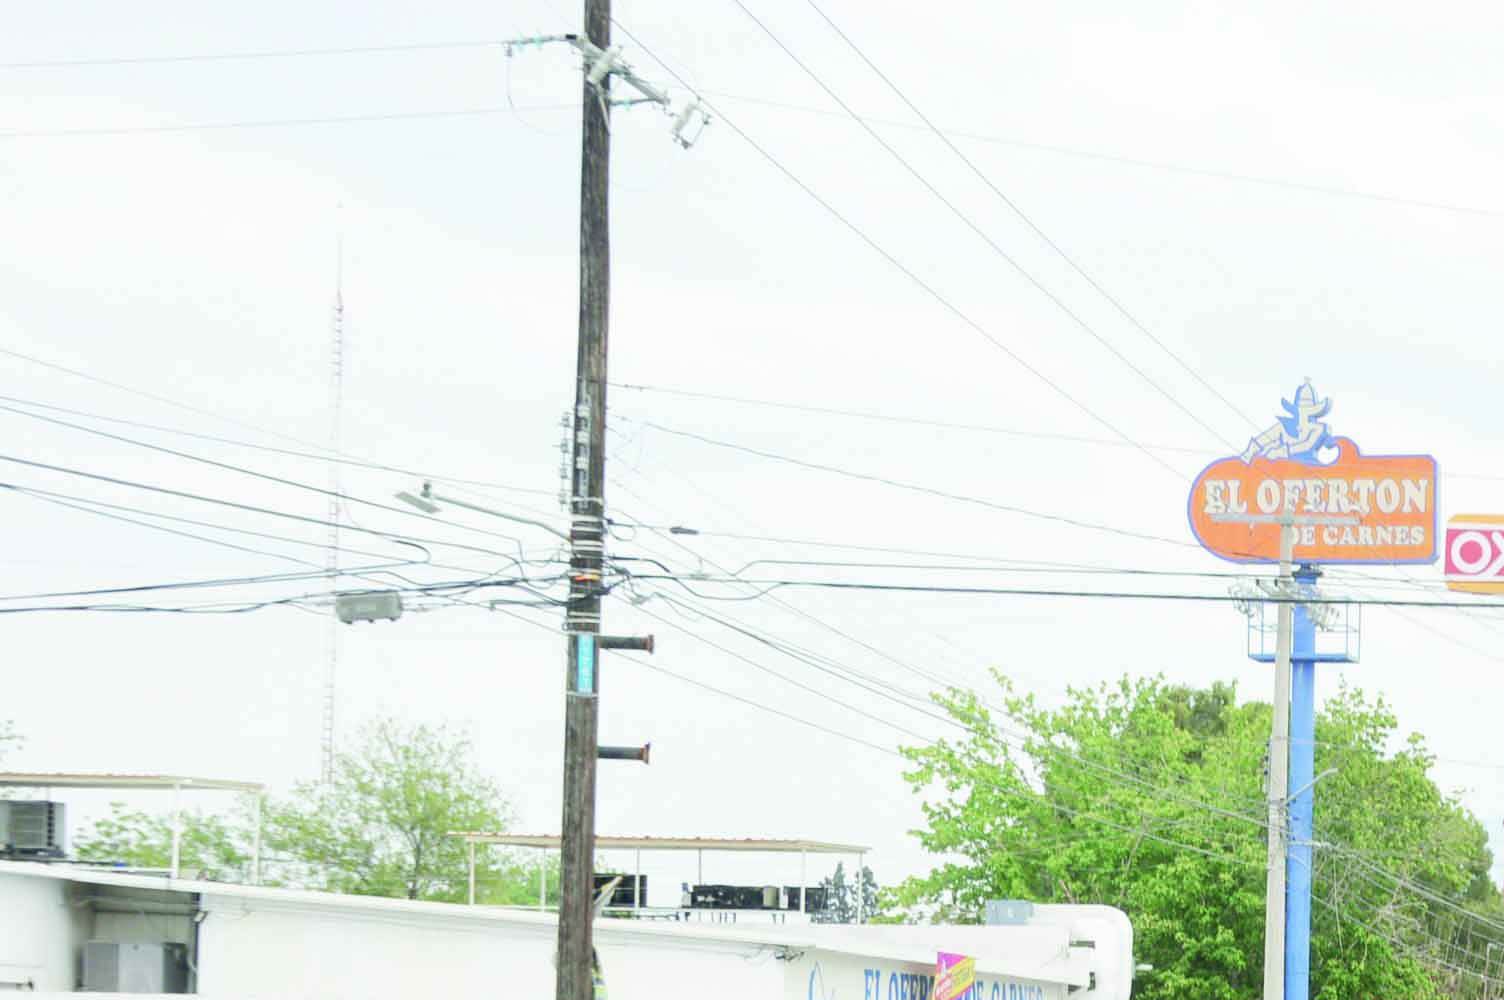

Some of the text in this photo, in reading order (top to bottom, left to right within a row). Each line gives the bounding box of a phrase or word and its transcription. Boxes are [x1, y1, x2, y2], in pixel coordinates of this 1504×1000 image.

[1203, 478, 1428, 515] EL OFERTON
[1323, 525, 1425, 546] CARNES
